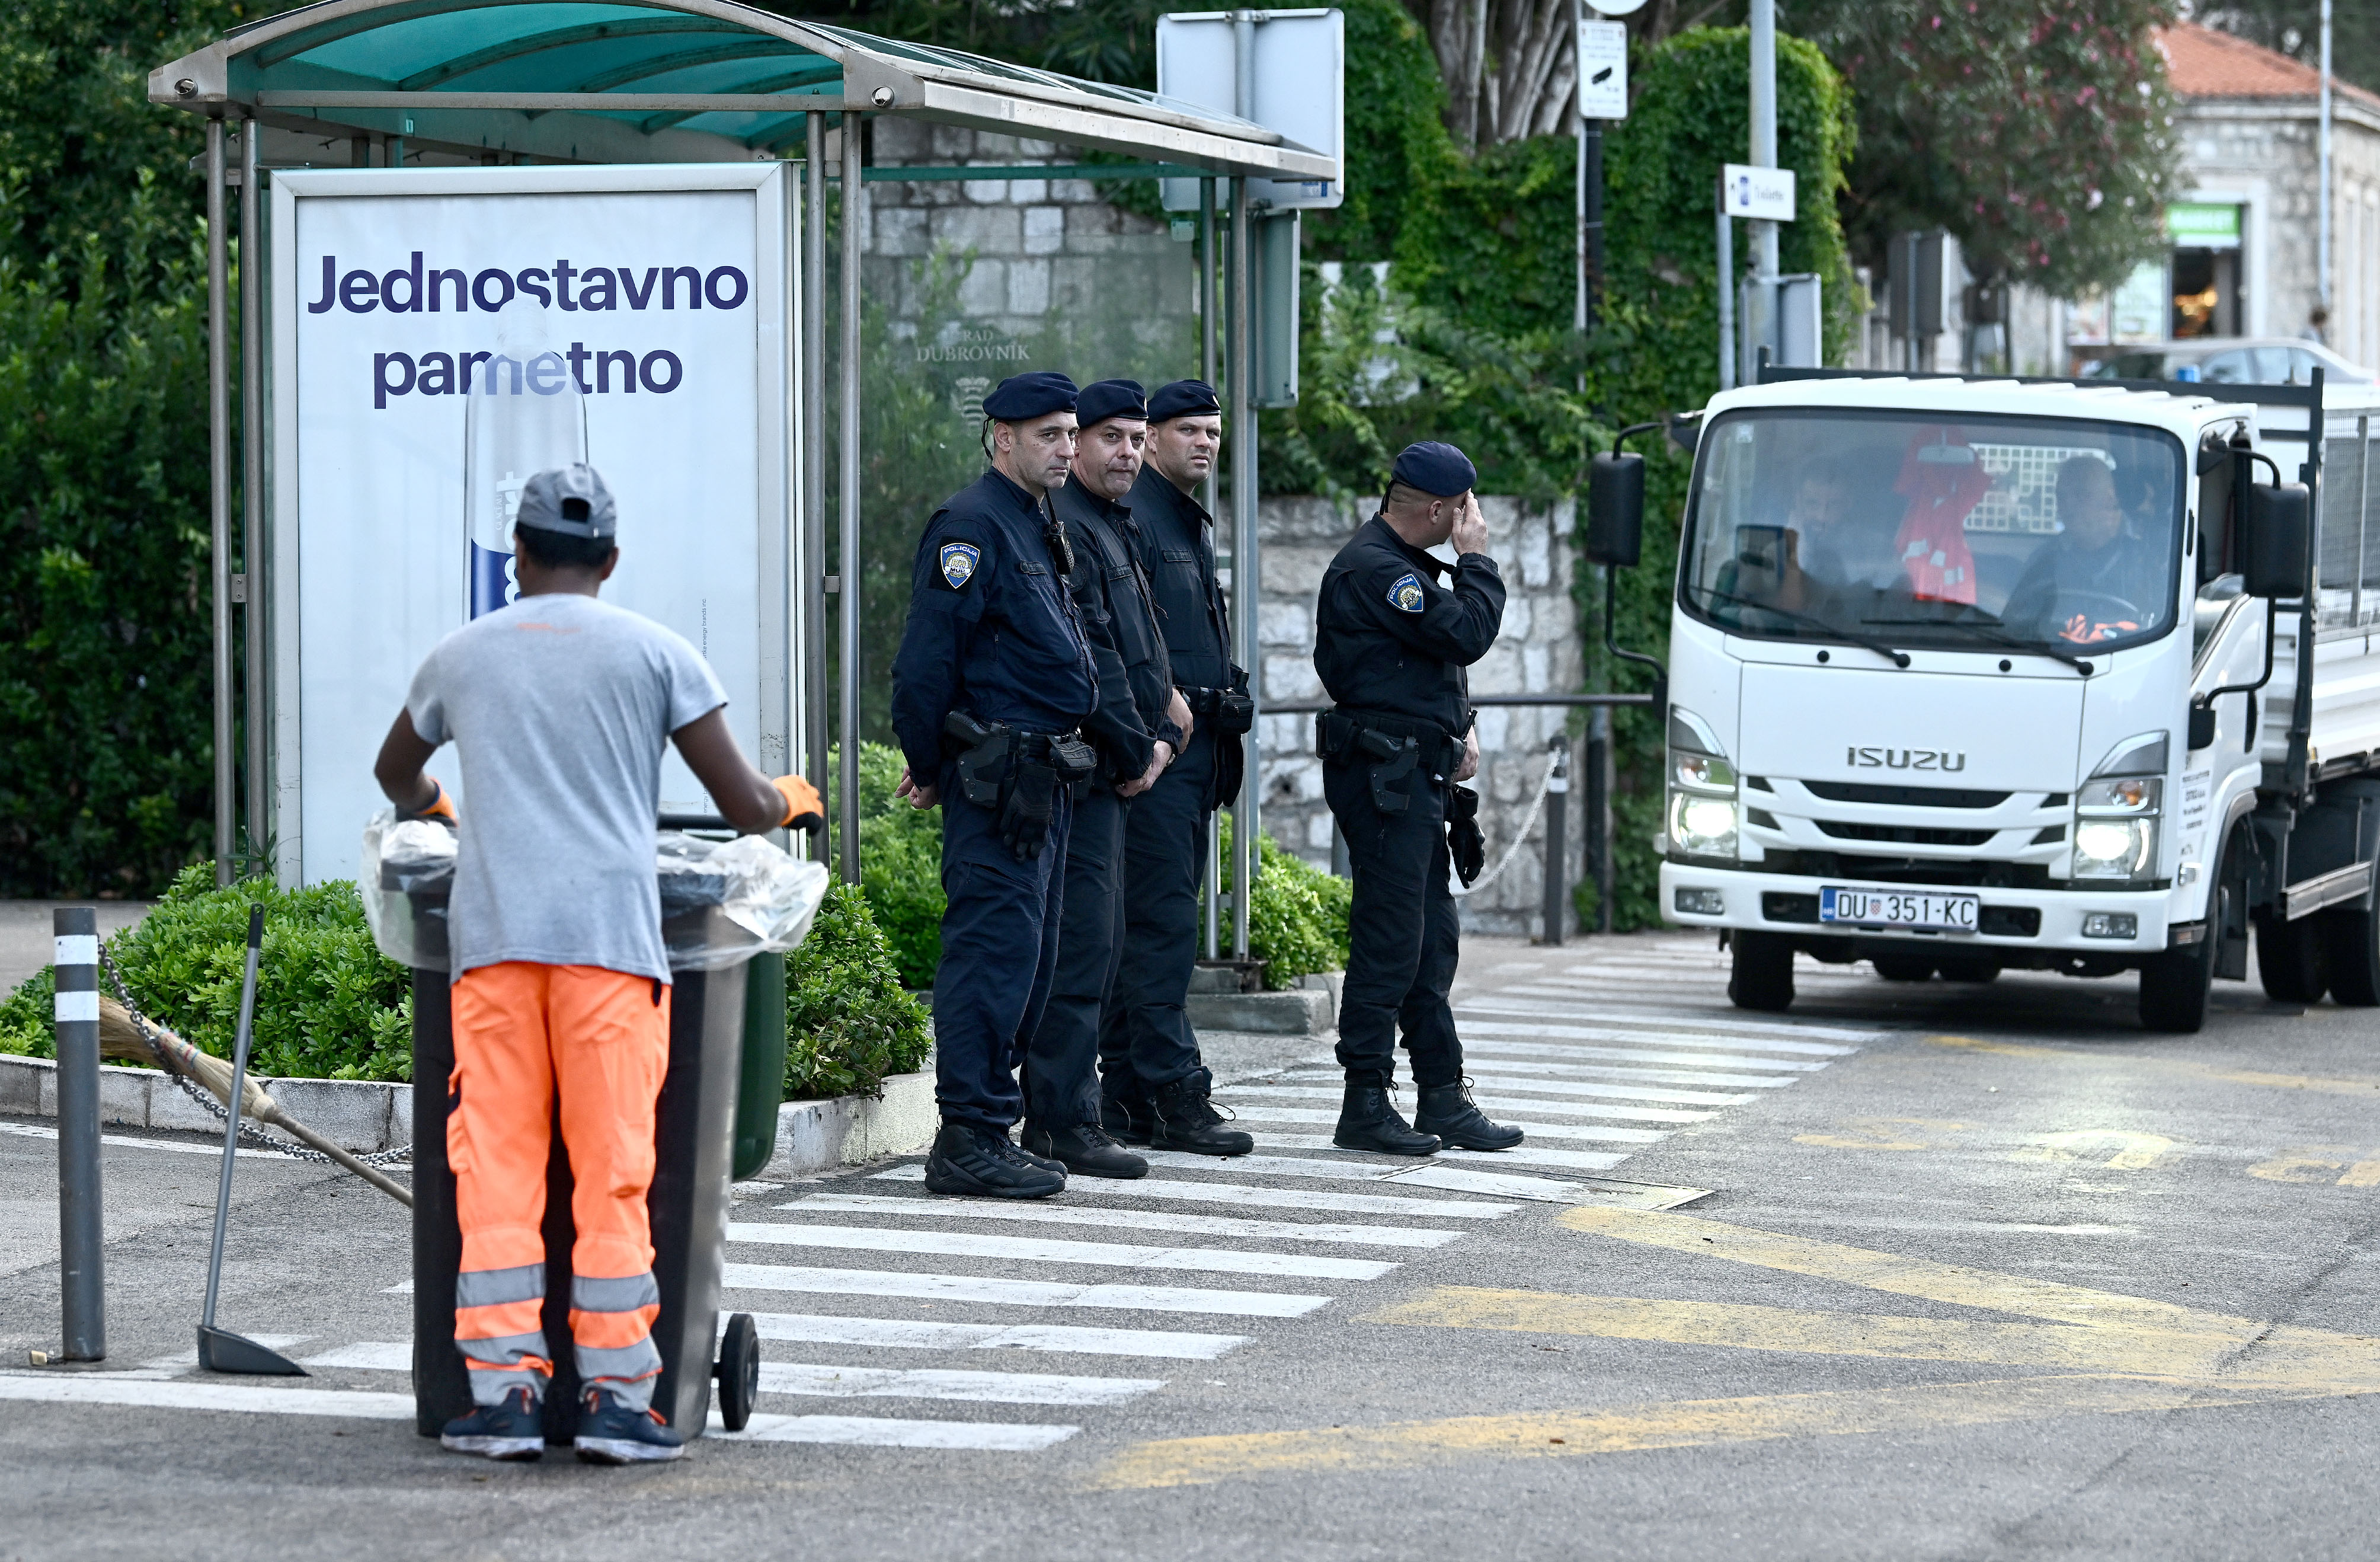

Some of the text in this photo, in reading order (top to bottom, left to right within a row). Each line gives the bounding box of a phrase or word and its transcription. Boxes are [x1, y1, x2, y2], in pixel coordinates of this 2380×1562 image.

[308, 251, 748, 314] Jednostavno
[952, 329, 994, 341] RAD
[917, 345, 1031, 361] DUBROVNIK
[374, 342, 683, 409] pametno
[943, 546, 977, 557] POLICIJA
[952, 560, 966, 568] RH
[1390, 577, 1413, 599] POLICIJA
[1847, 745, 1965, 772] ISUZU
[1838, 894, 1866, 919] DU
